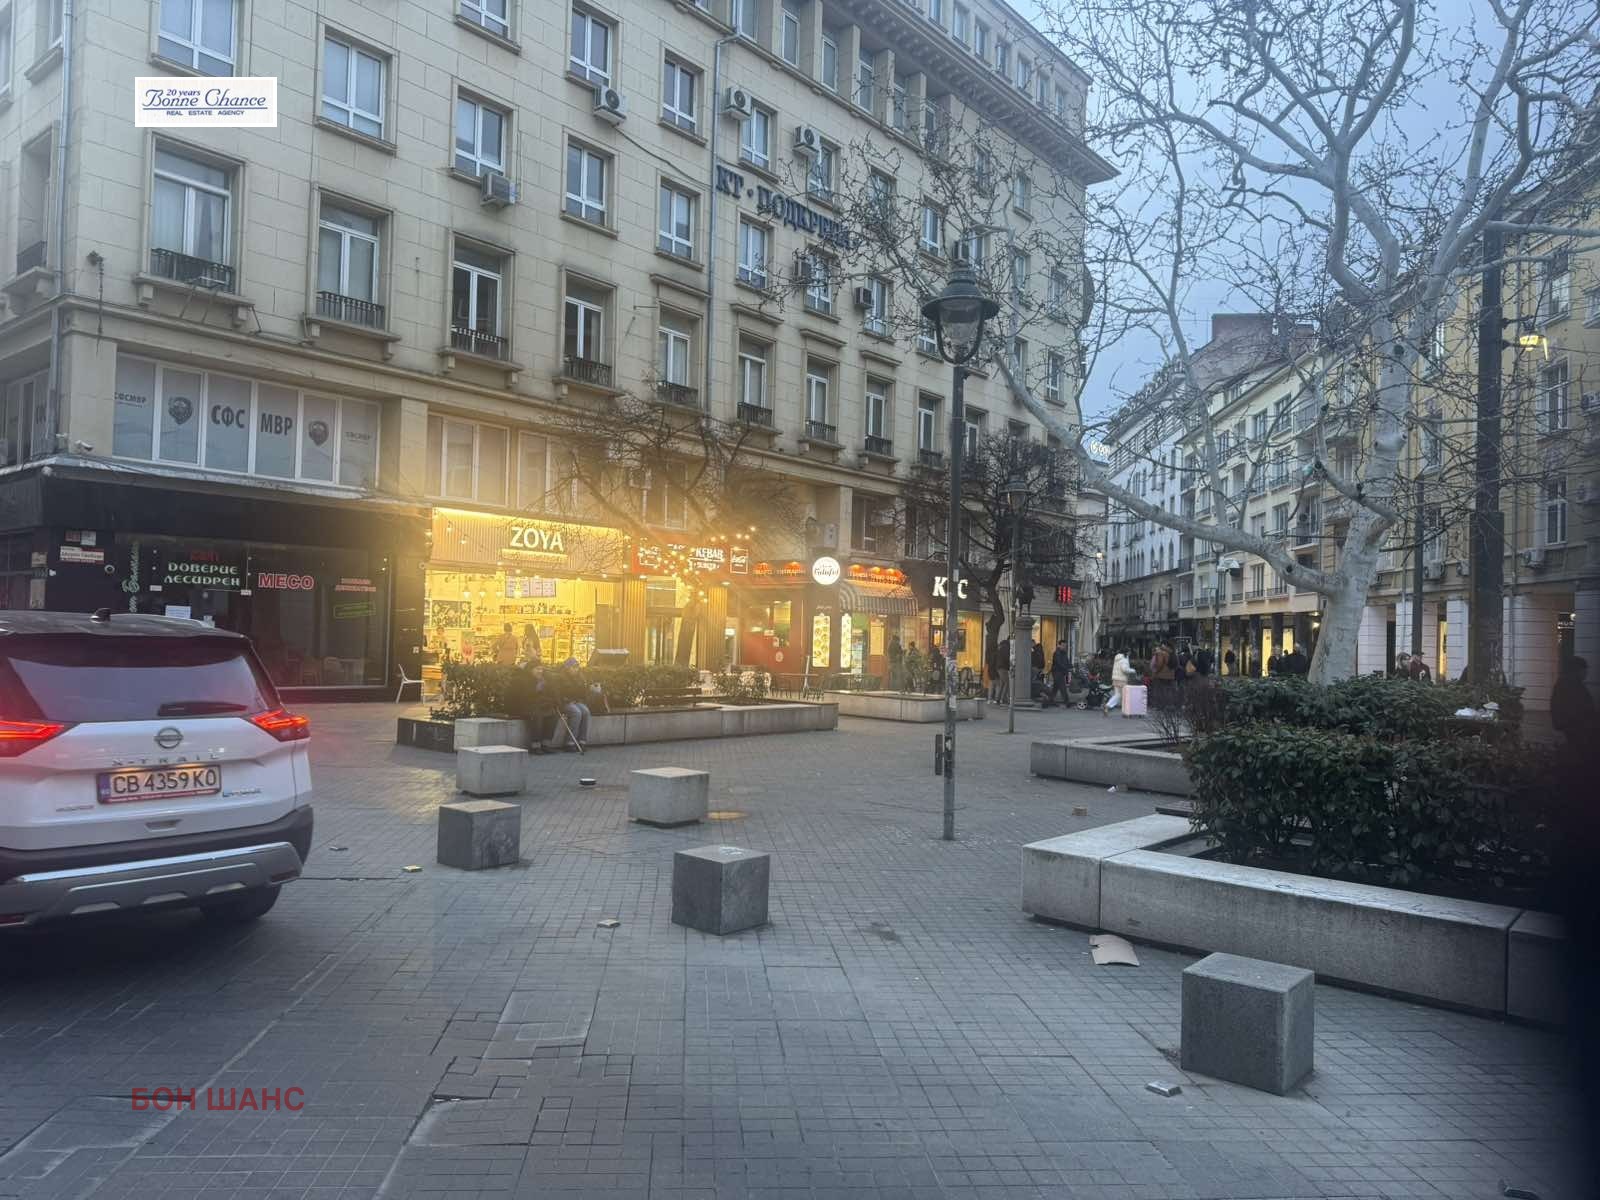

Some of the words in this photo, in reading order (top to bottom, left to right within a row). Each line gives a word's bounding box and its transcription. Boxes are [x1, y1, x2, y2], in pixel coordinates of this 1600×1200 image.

[211, 404, 246, 429] СФС
[260, 413, 294, 436] МВР
[509, 526, 564, 552] ZOYA
[932, 576, 969, 599] KC
[144, 771, 189, 792] 4359
